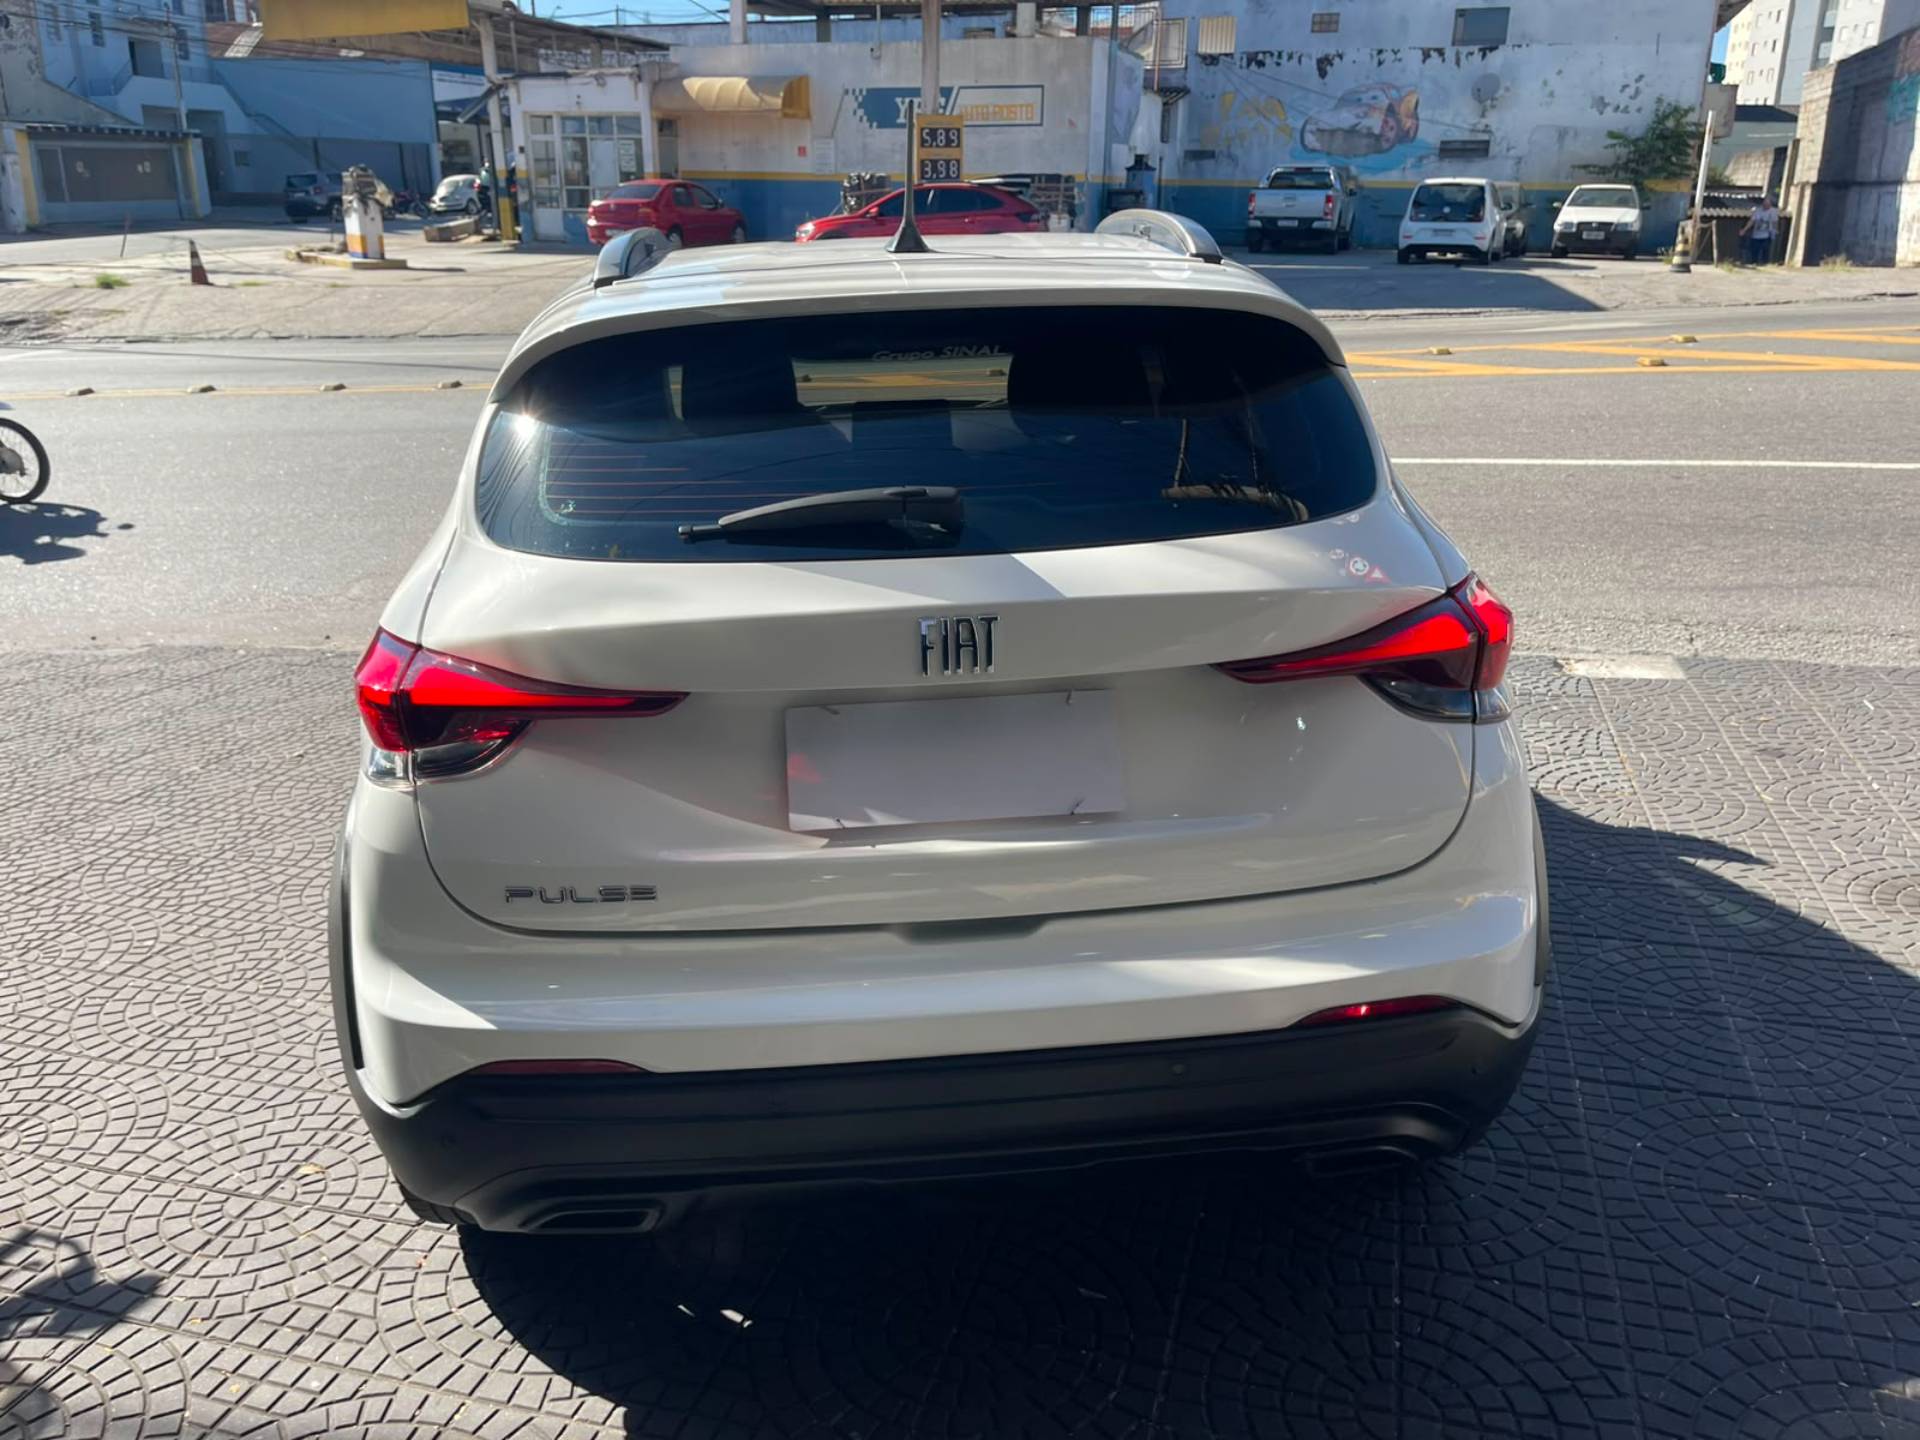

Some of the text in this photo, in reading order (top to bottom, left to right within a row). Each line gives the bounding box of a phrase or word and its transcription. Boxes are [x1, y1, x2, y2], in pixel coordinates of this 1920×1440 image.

[992, 103, 1034, 121] POSTO
[872, 344, 1009, 362] Grupo SINAL
[919, 615, 1000, 677] FIAT
[505, 885, 658, 904] PULSE
